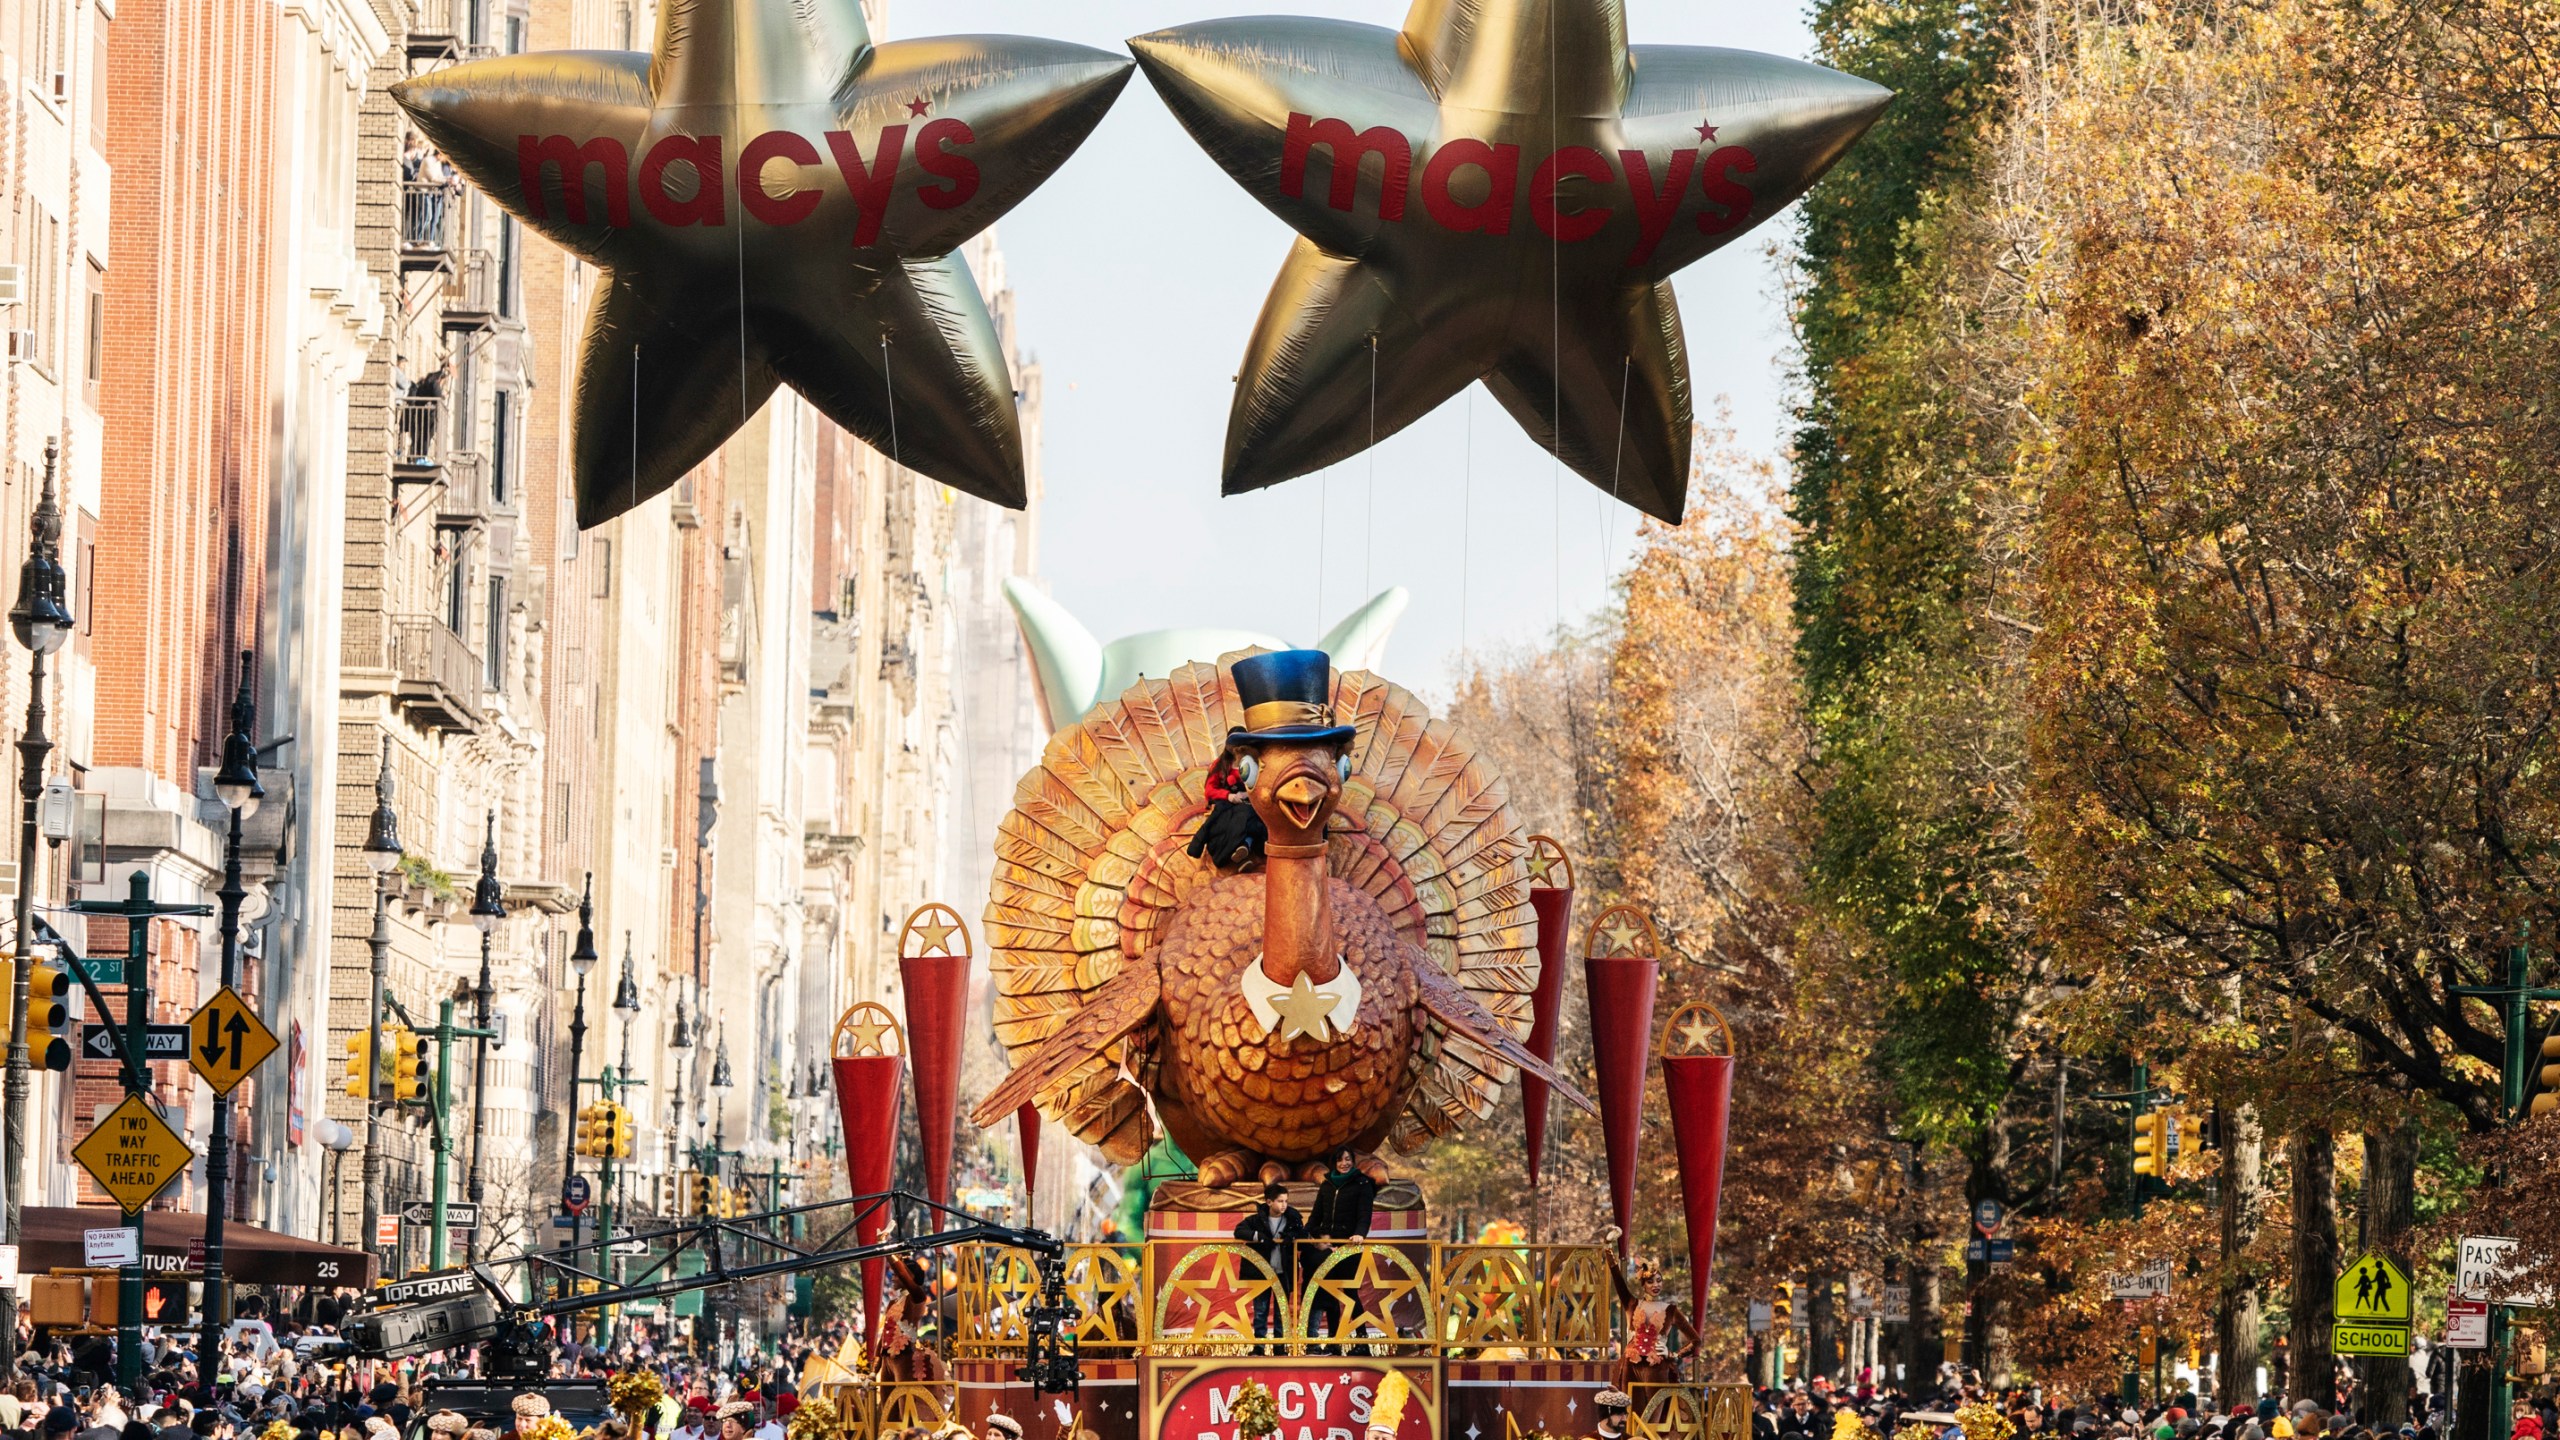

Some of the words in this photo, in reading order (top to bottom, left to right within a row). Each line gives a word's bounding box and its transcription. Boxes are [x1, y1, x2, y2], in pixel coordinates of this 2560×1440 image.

[110, 962, 120, 972] ST
[120, 1117, 148, 1131] TWO
[120, 1136, 147, 1149] WAY
[106, 1153, 161, 1168] TRAFFIC
[110, 1172, 155, 1186] AHEAD
[446, 1210, 470, 1220] WAY
[99, 1231, 126, 1240] PARKING
[89, 1241, 115, 1250] Anytime
[317, 1261, 340, 1279] 25
[2138, 1275, 2166, 1290] ONLY
[2338, 1331, 2403, 1348] SCHOOL
